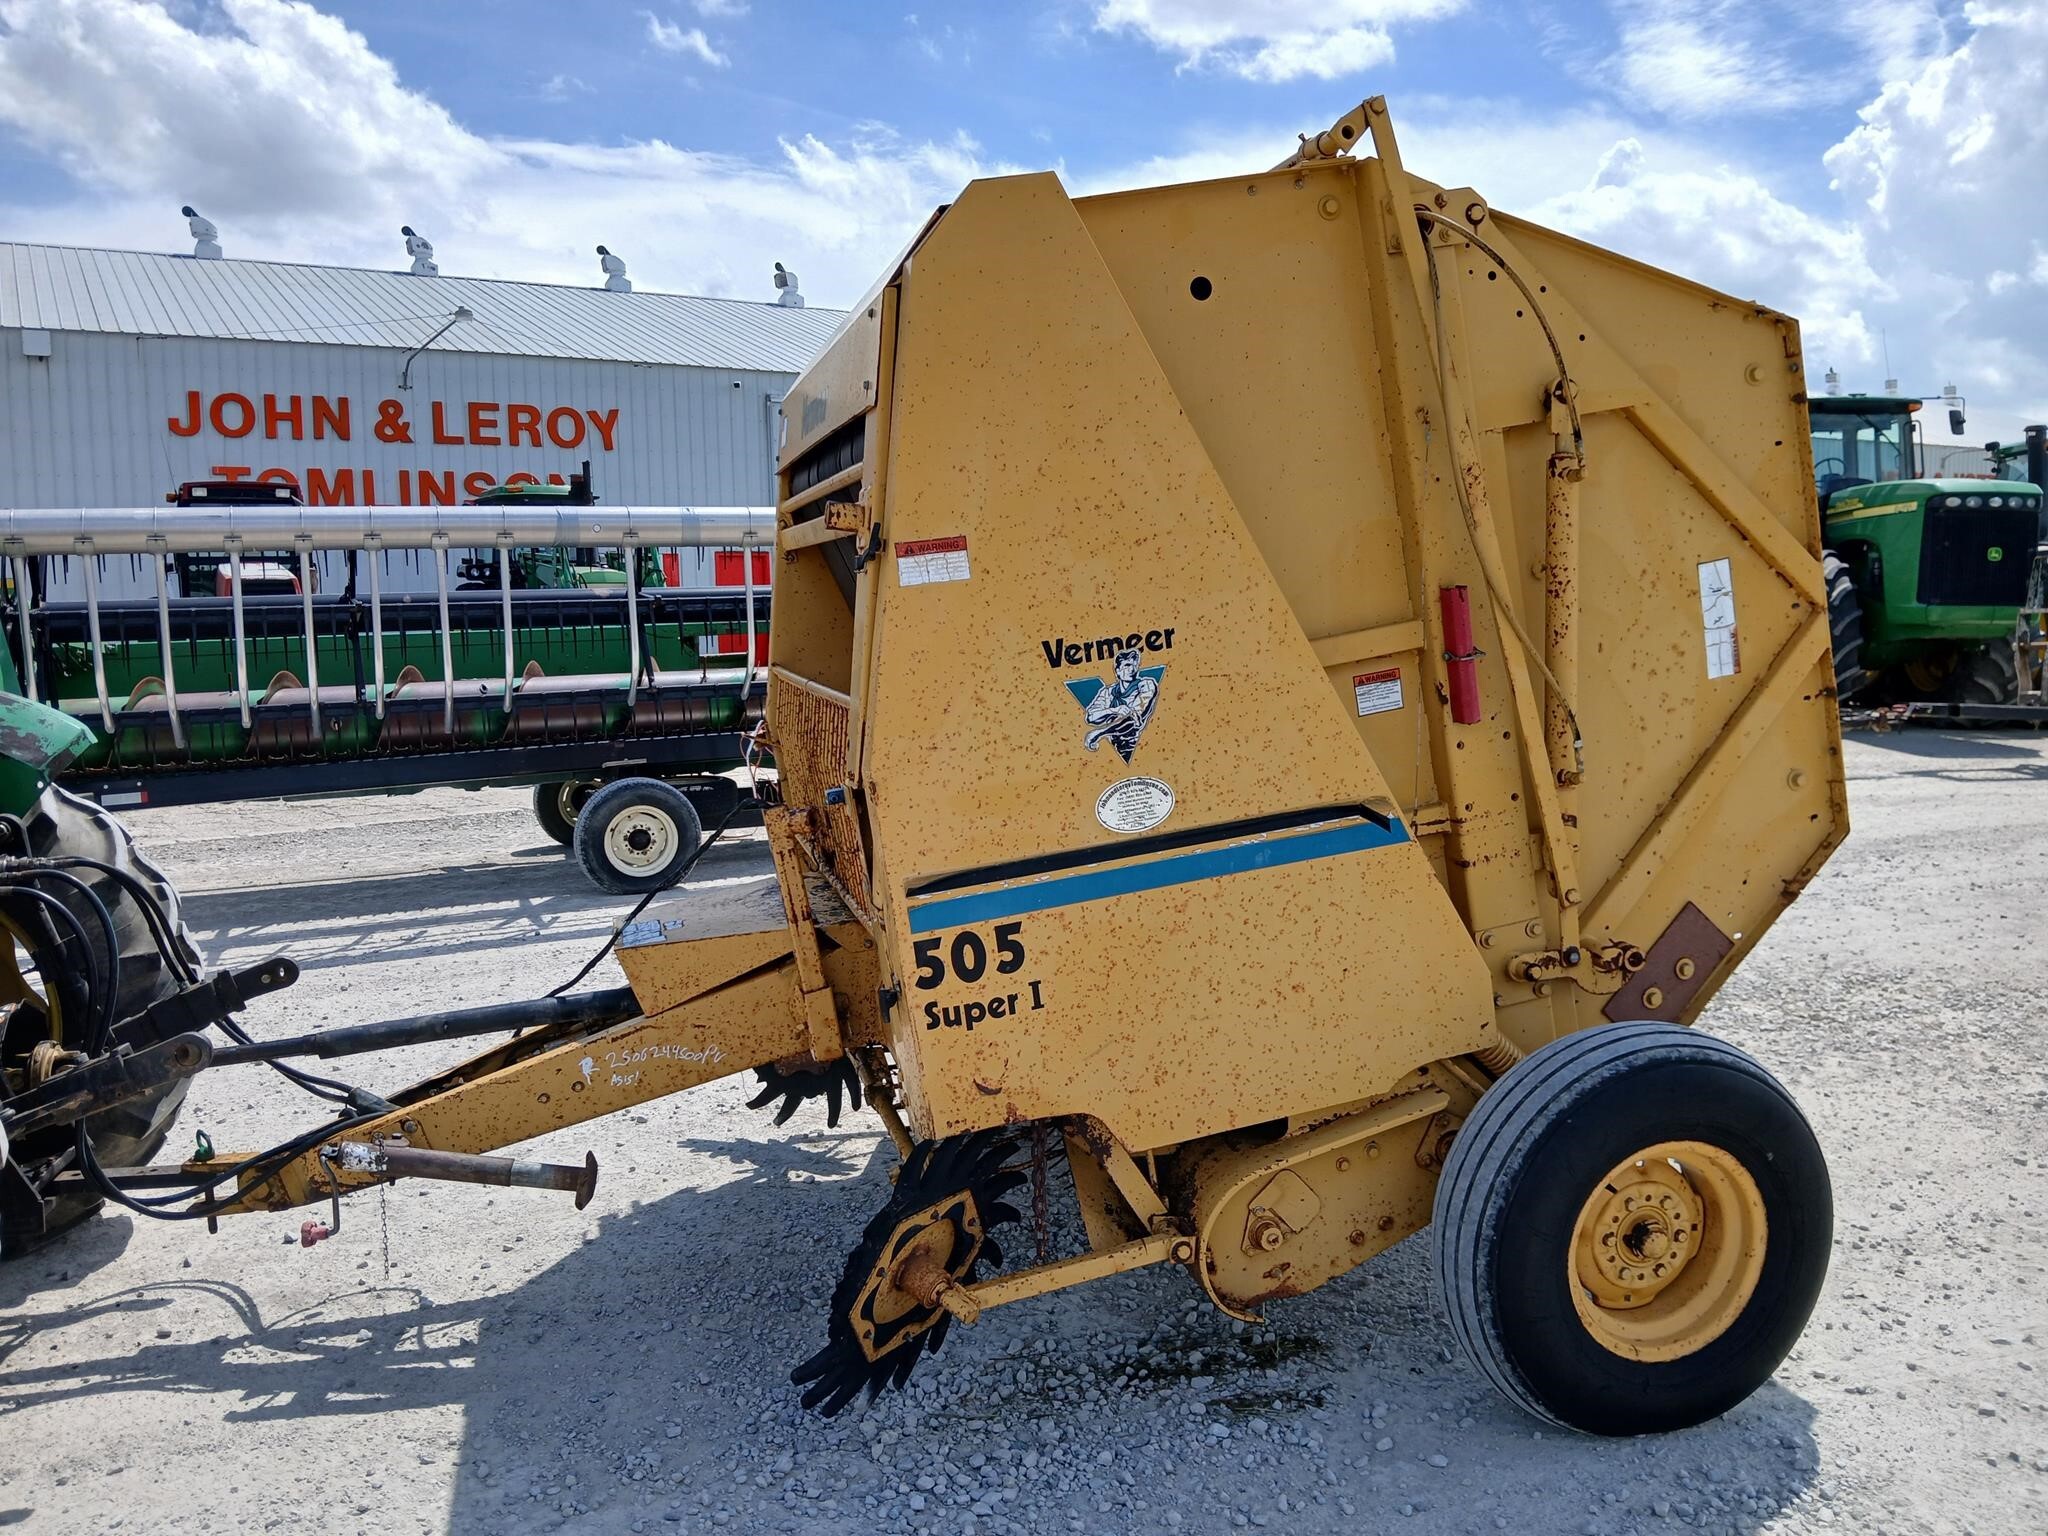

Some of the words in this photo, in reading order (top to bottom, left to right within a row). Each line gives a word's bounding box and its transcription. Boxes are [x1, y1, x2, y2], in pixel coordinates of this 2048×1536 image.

[168, 390, 351, 441] JOHN
[374, 399, 415, 443] &
[432, 401, 619, 451] LEROY
[212, 466, 583, 506] TMLINS
[917, 541, 960, 553] WARNING
[1041, 628, 1175, 668] Vermeer
[1364, 671, 1397, 683] WARNING
[913, 921, 1025, 990] 505
[924, 993, 1018, 1031] Super
[1028, 980, 1045, 1010] I
